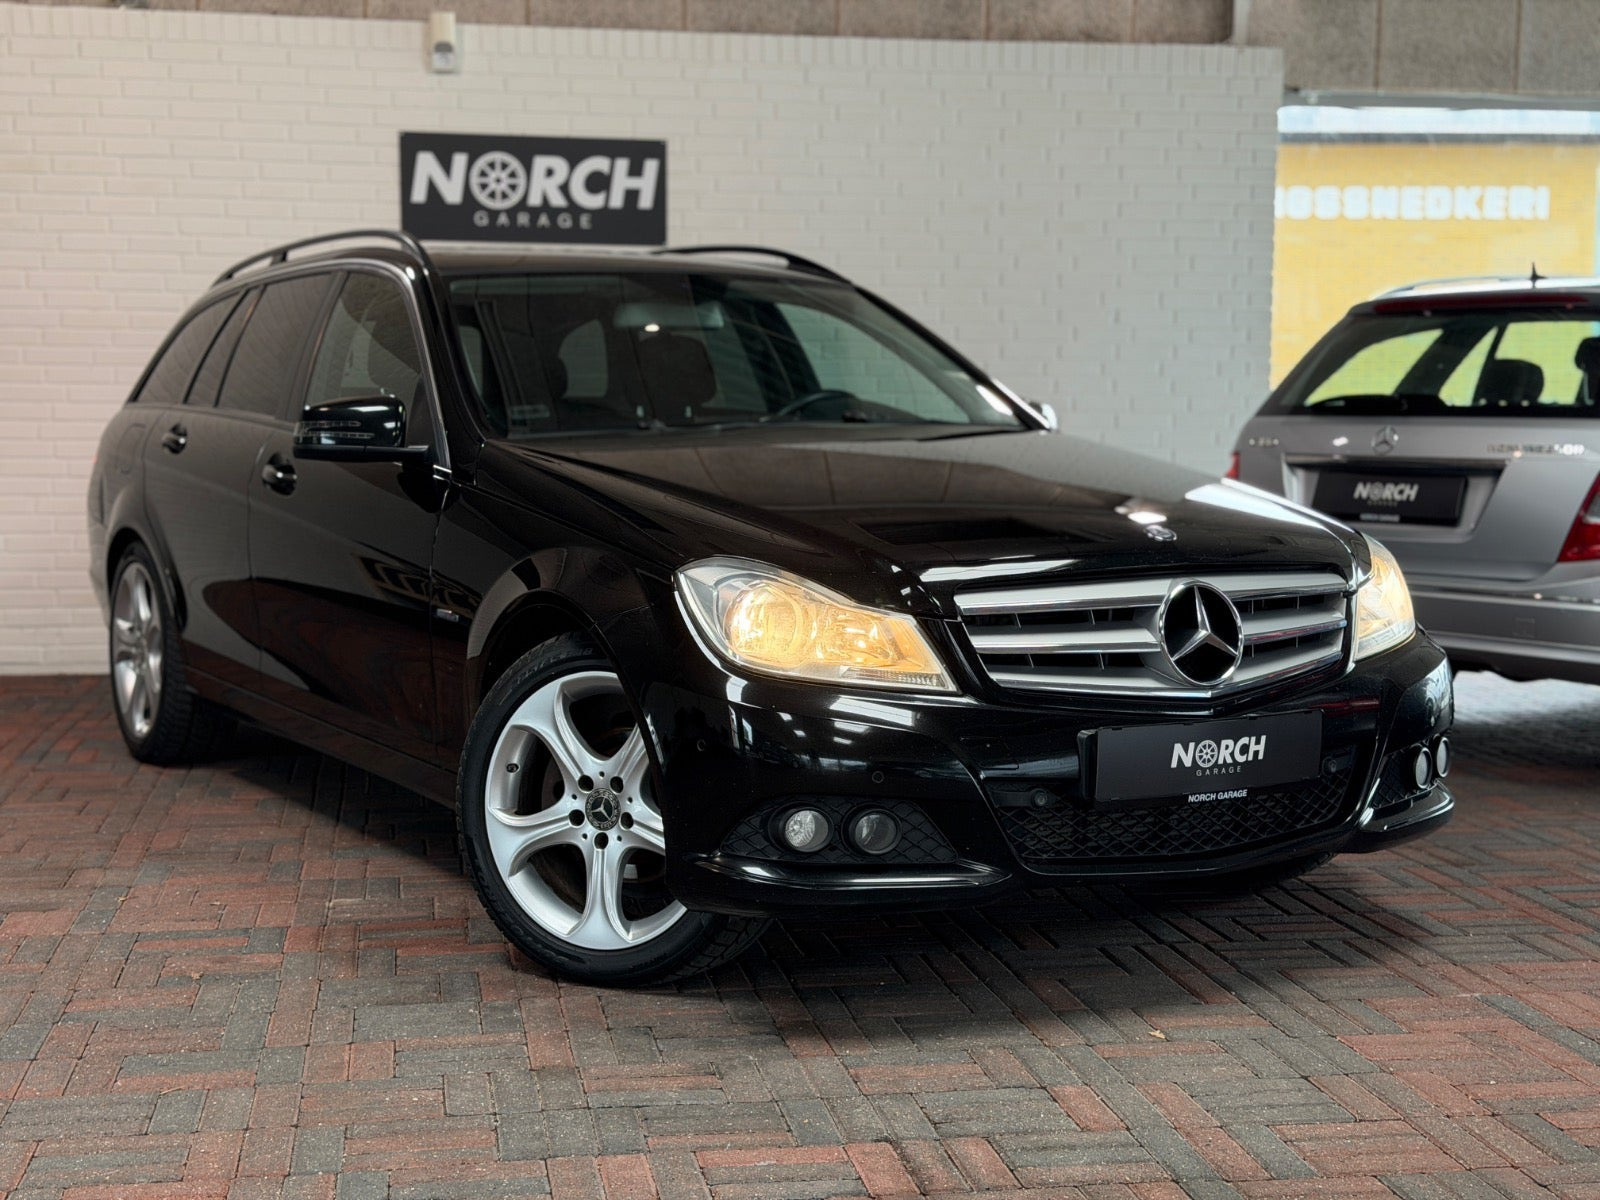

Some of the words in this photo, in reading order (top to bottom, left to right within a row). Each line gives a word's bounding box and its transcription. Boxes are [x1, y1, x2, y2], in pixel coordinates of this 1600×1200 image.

[410, 150, 661, 211] NORCH
[473, 210, 593, 230] GARAGE
[1171, 735, 1266, 768] NORCH
[1196, 766, 1241, 776] GARAGE
[1188, 792, 1216, 803] NORCH
[1217, 789, 1248, 800] GARAGE
